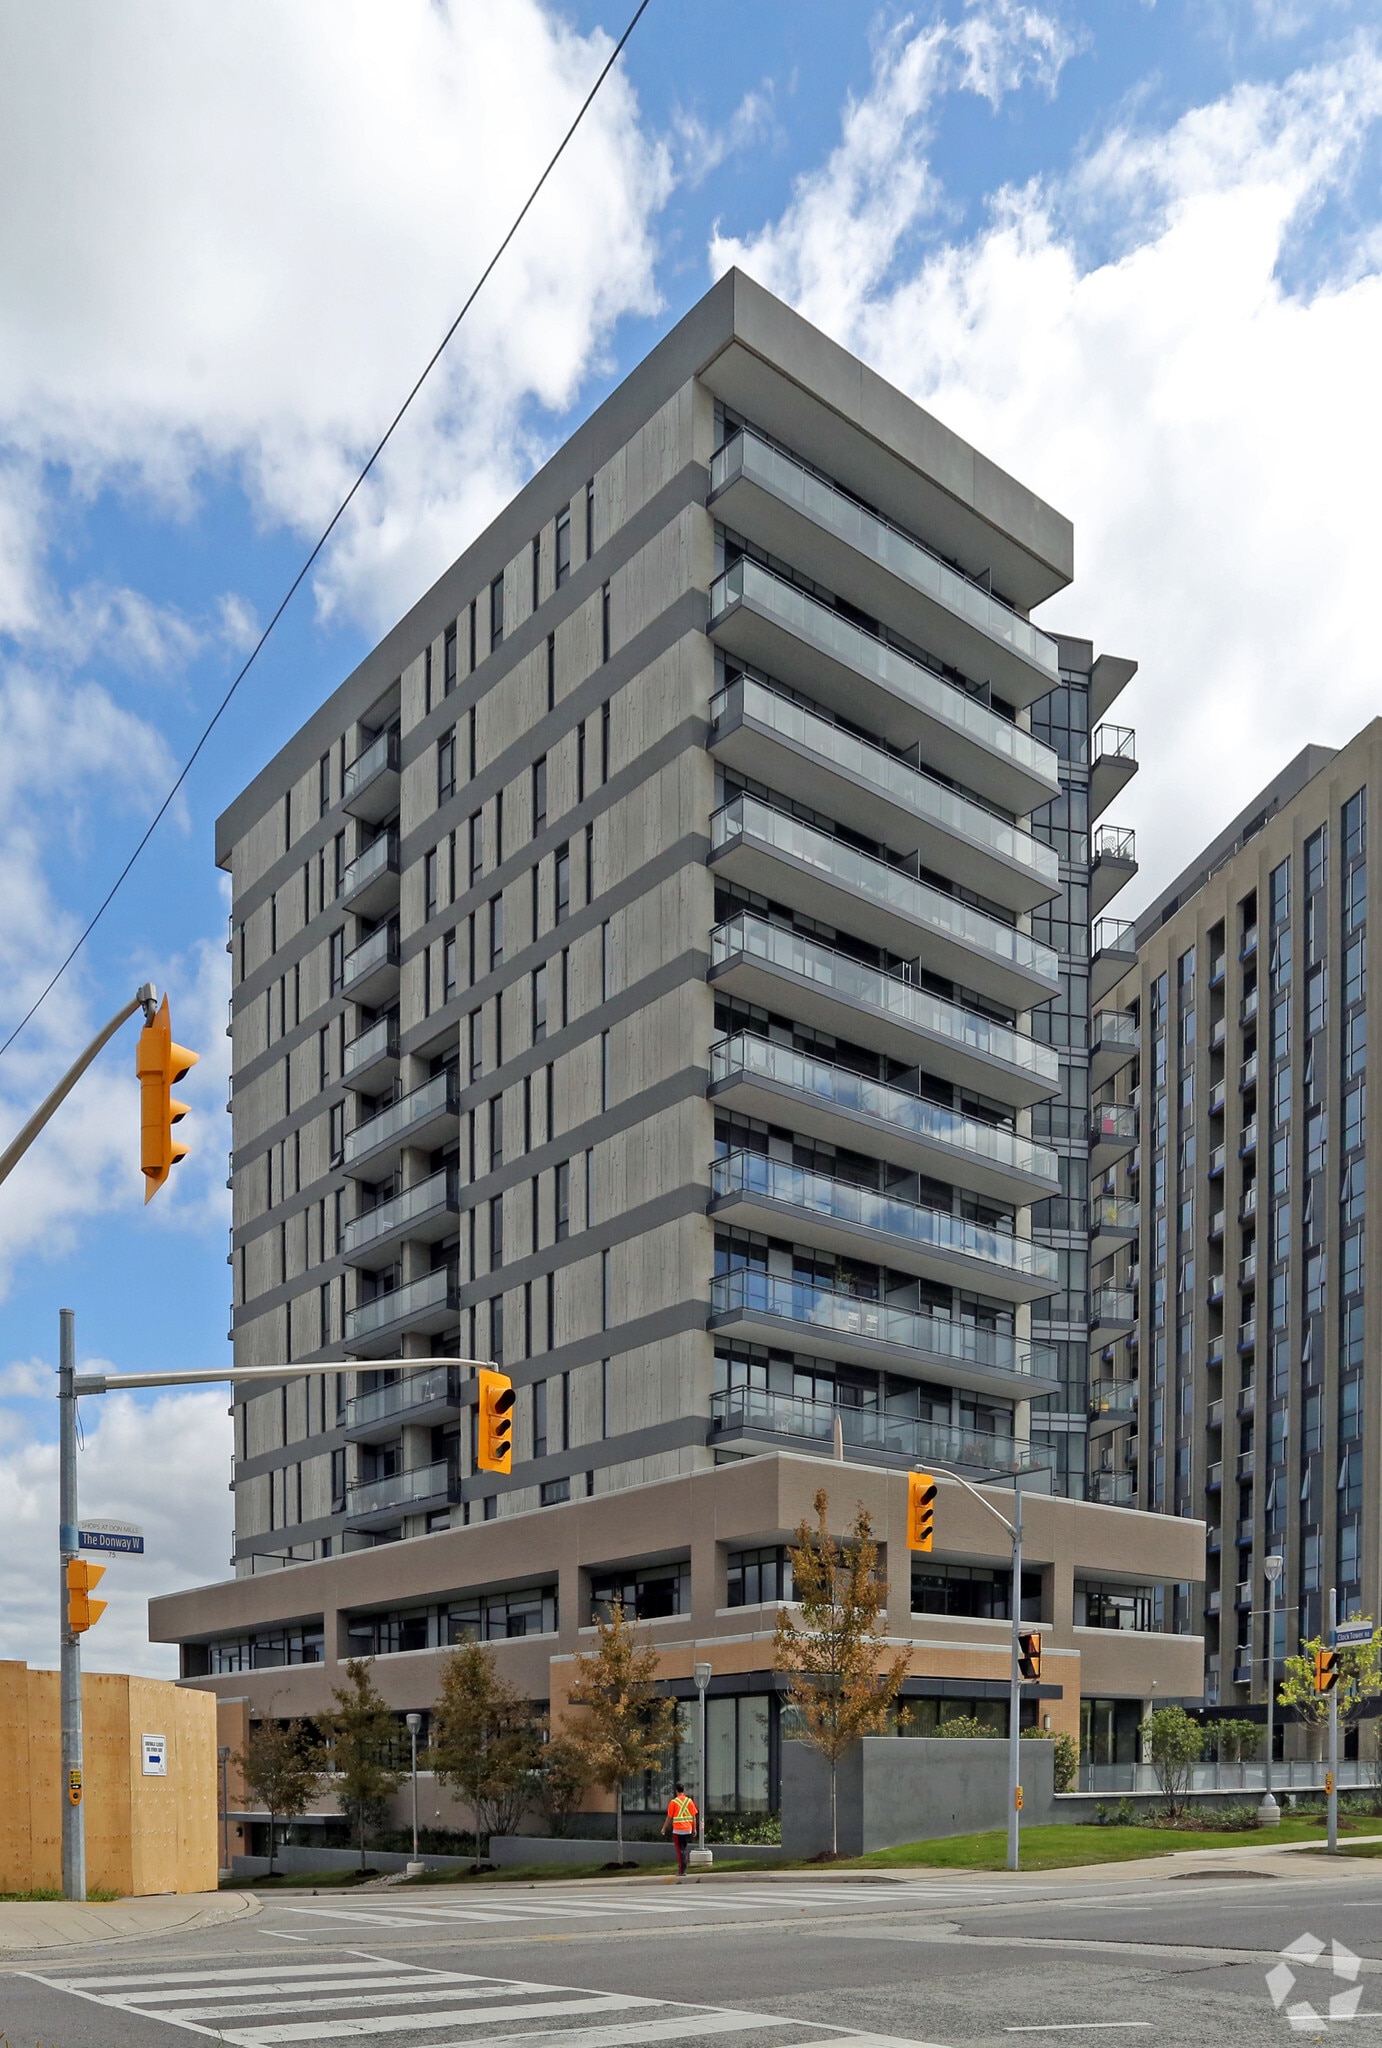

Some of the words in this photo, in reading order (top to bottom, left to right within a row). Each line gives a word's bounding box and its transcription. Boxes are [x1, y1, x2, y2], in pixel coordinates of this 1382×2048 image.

[83, 1533, 97, 1545] The
[99, 1535, 131, 1550] Donway
[132, 1537, 140, 1549] W
[1337, 1633, 1350, 1641] Clock
